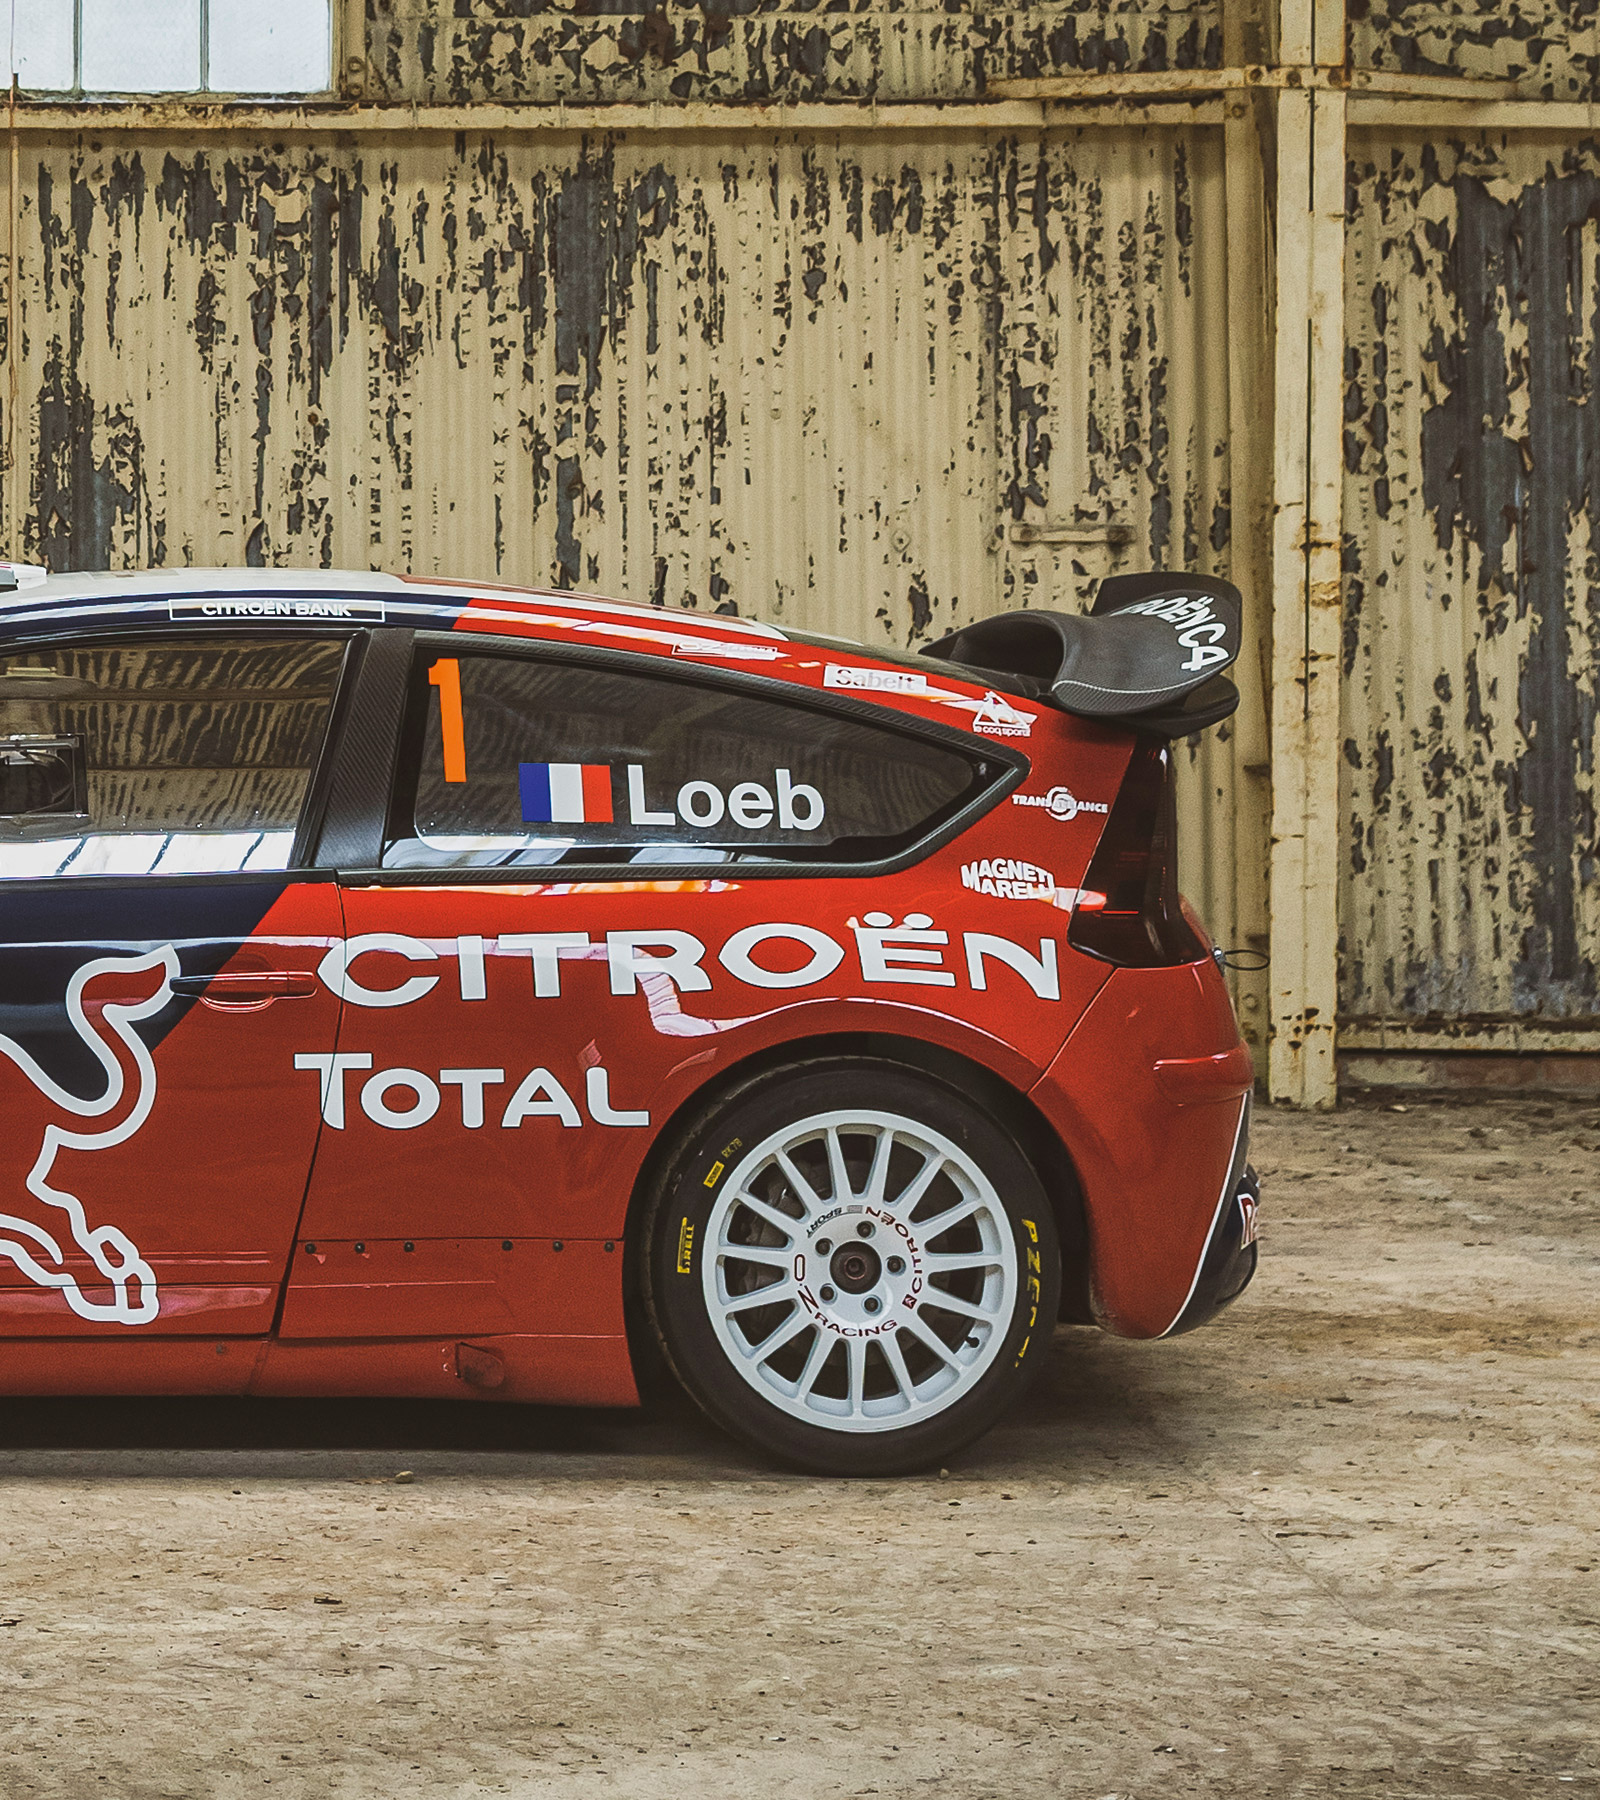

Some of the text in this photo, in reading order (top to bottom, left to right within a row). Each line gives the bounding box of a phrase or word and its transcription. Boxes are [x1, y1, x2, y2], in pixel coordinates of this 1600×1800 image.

[201, 600, 352, 617] CITROËN BANK
[428, 657, 467, 783] 1
[983, 726, 1002, 736] coq
[628, 764, 825, 831] Loeb
[961, 858, 1055, 889] MAGNETI
[317, 911, 1061, 1007] CITROËN
[293, 1052, 650, 1129] TOTAL
[806, 1206, 842, 1238] SPORT
[814, 1311, 898, 1337] RACING
